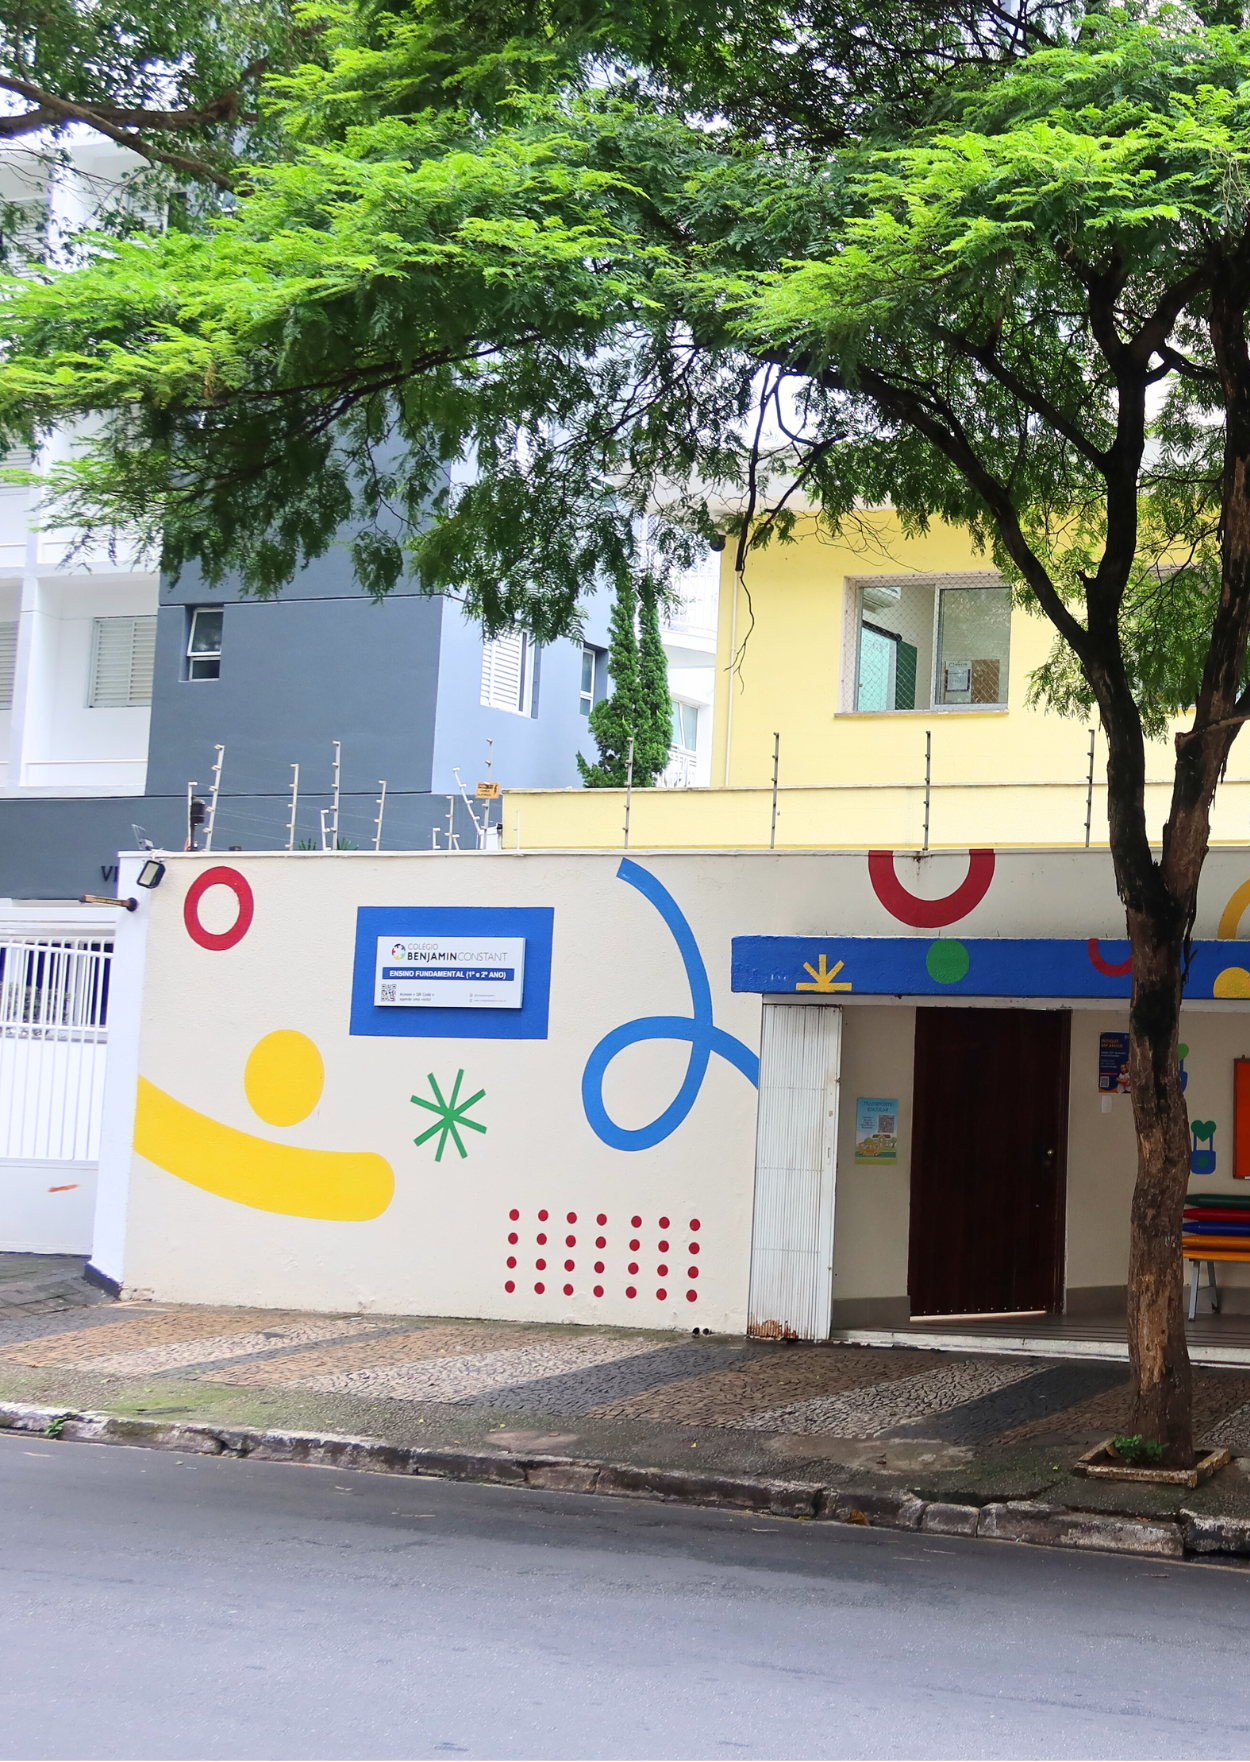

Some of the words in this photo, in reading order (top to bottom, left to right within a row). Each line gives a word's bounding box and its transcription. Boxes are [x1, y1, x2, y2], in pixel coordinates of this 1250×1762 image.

[408, 943, 439, 951] COLÉGIO
[415, 970, 464, 978] FUNDAMENTAL
[489, 971, 507, 979] ANO)
